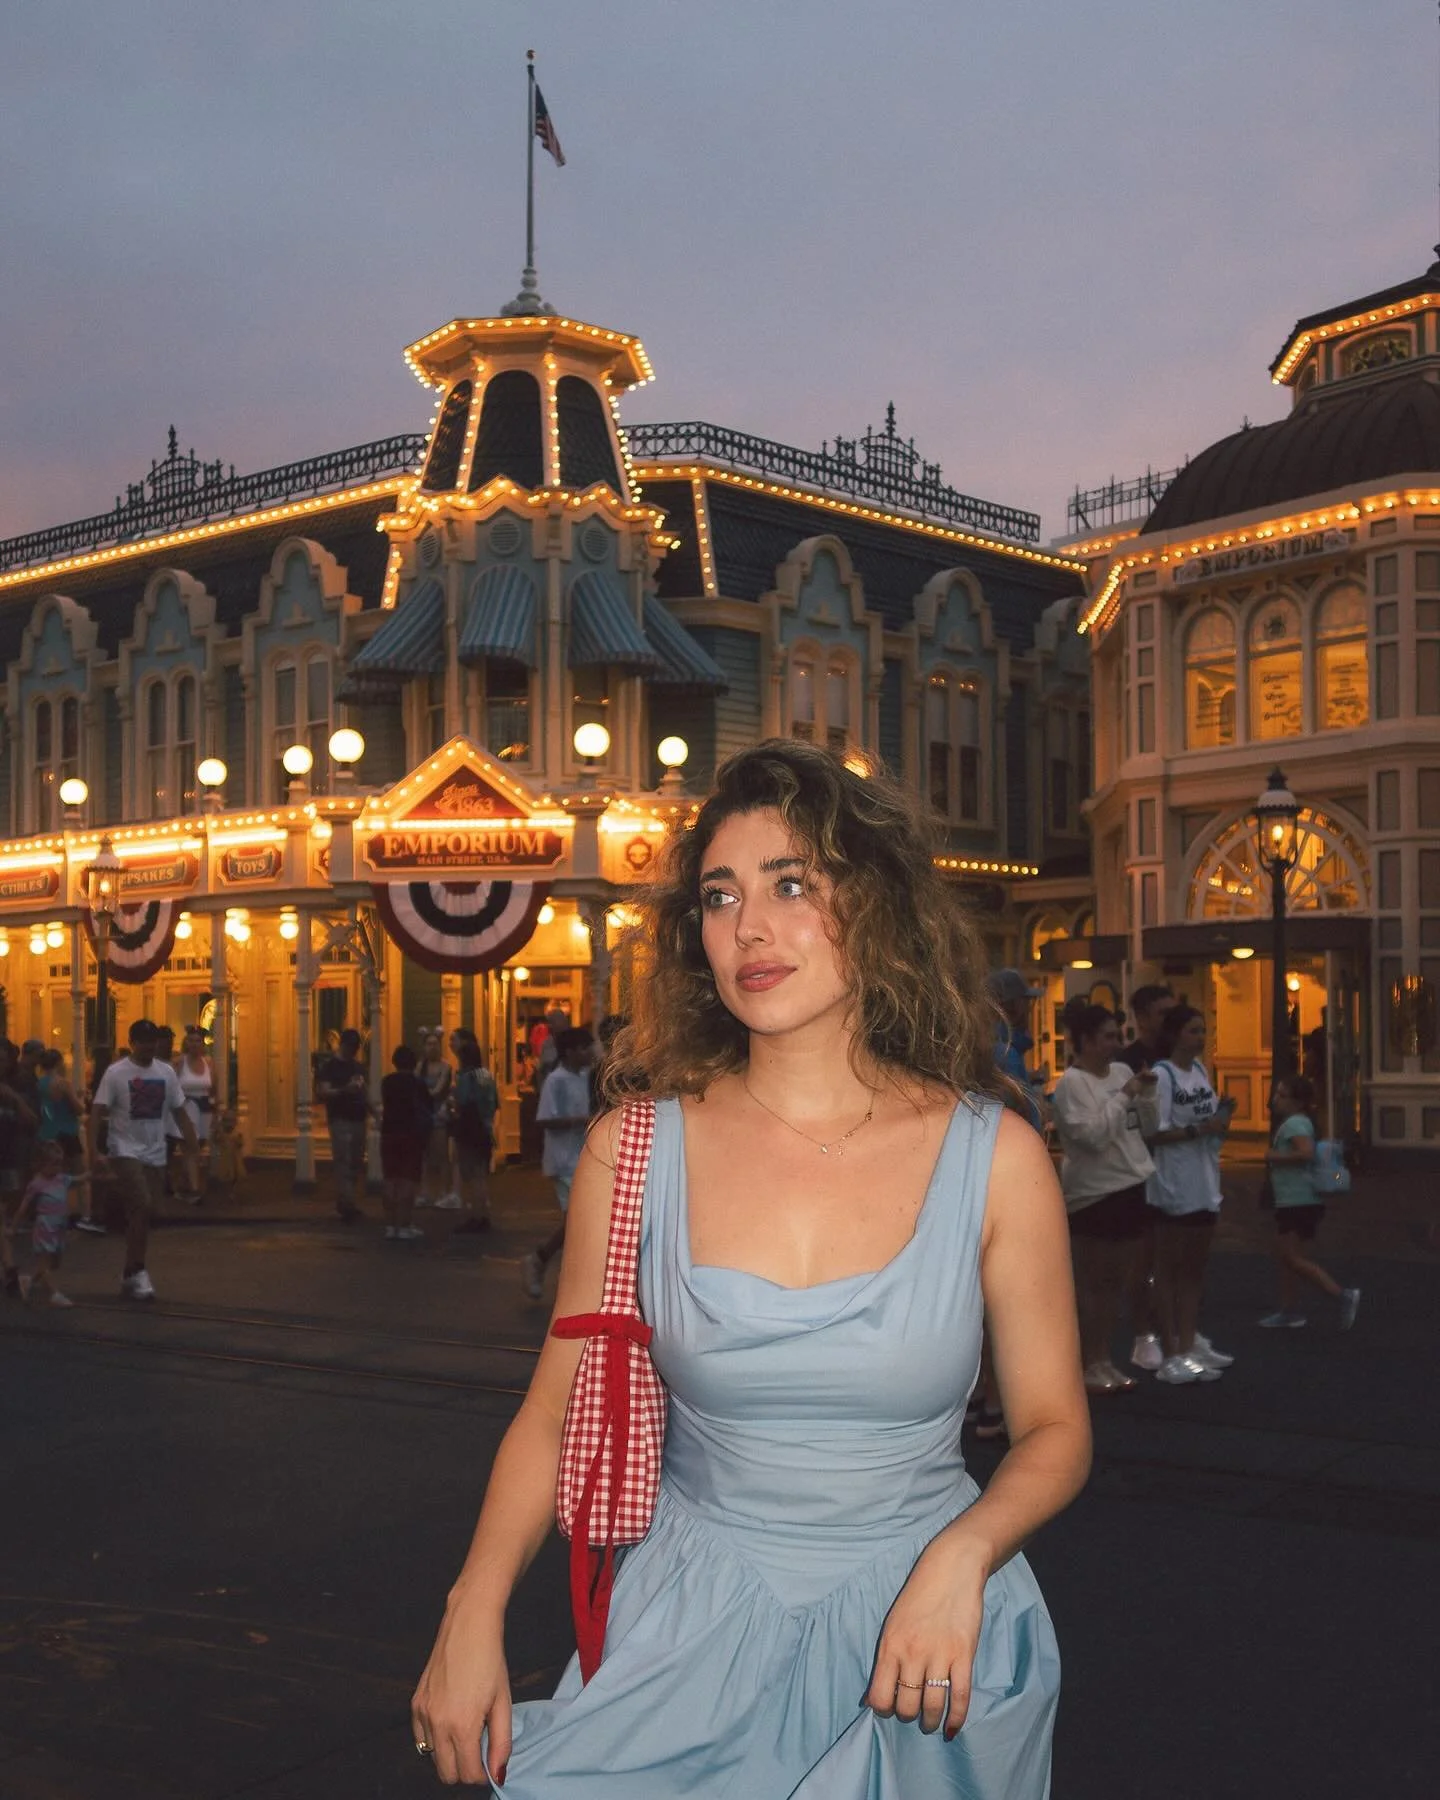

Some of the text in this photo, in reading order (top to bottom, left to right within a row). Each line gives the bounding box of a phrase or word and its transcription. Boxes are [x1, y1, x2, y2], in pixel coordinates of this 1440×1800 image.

[1201, 532, 1325, 577] EMPORIUM
[381, 831, 546, 859] EMPORIUM
[236, 861, 266, 874] TOYS
[416, 856, 443, 865] MAIN
[118, 868, 174, 888] EPSAKES
